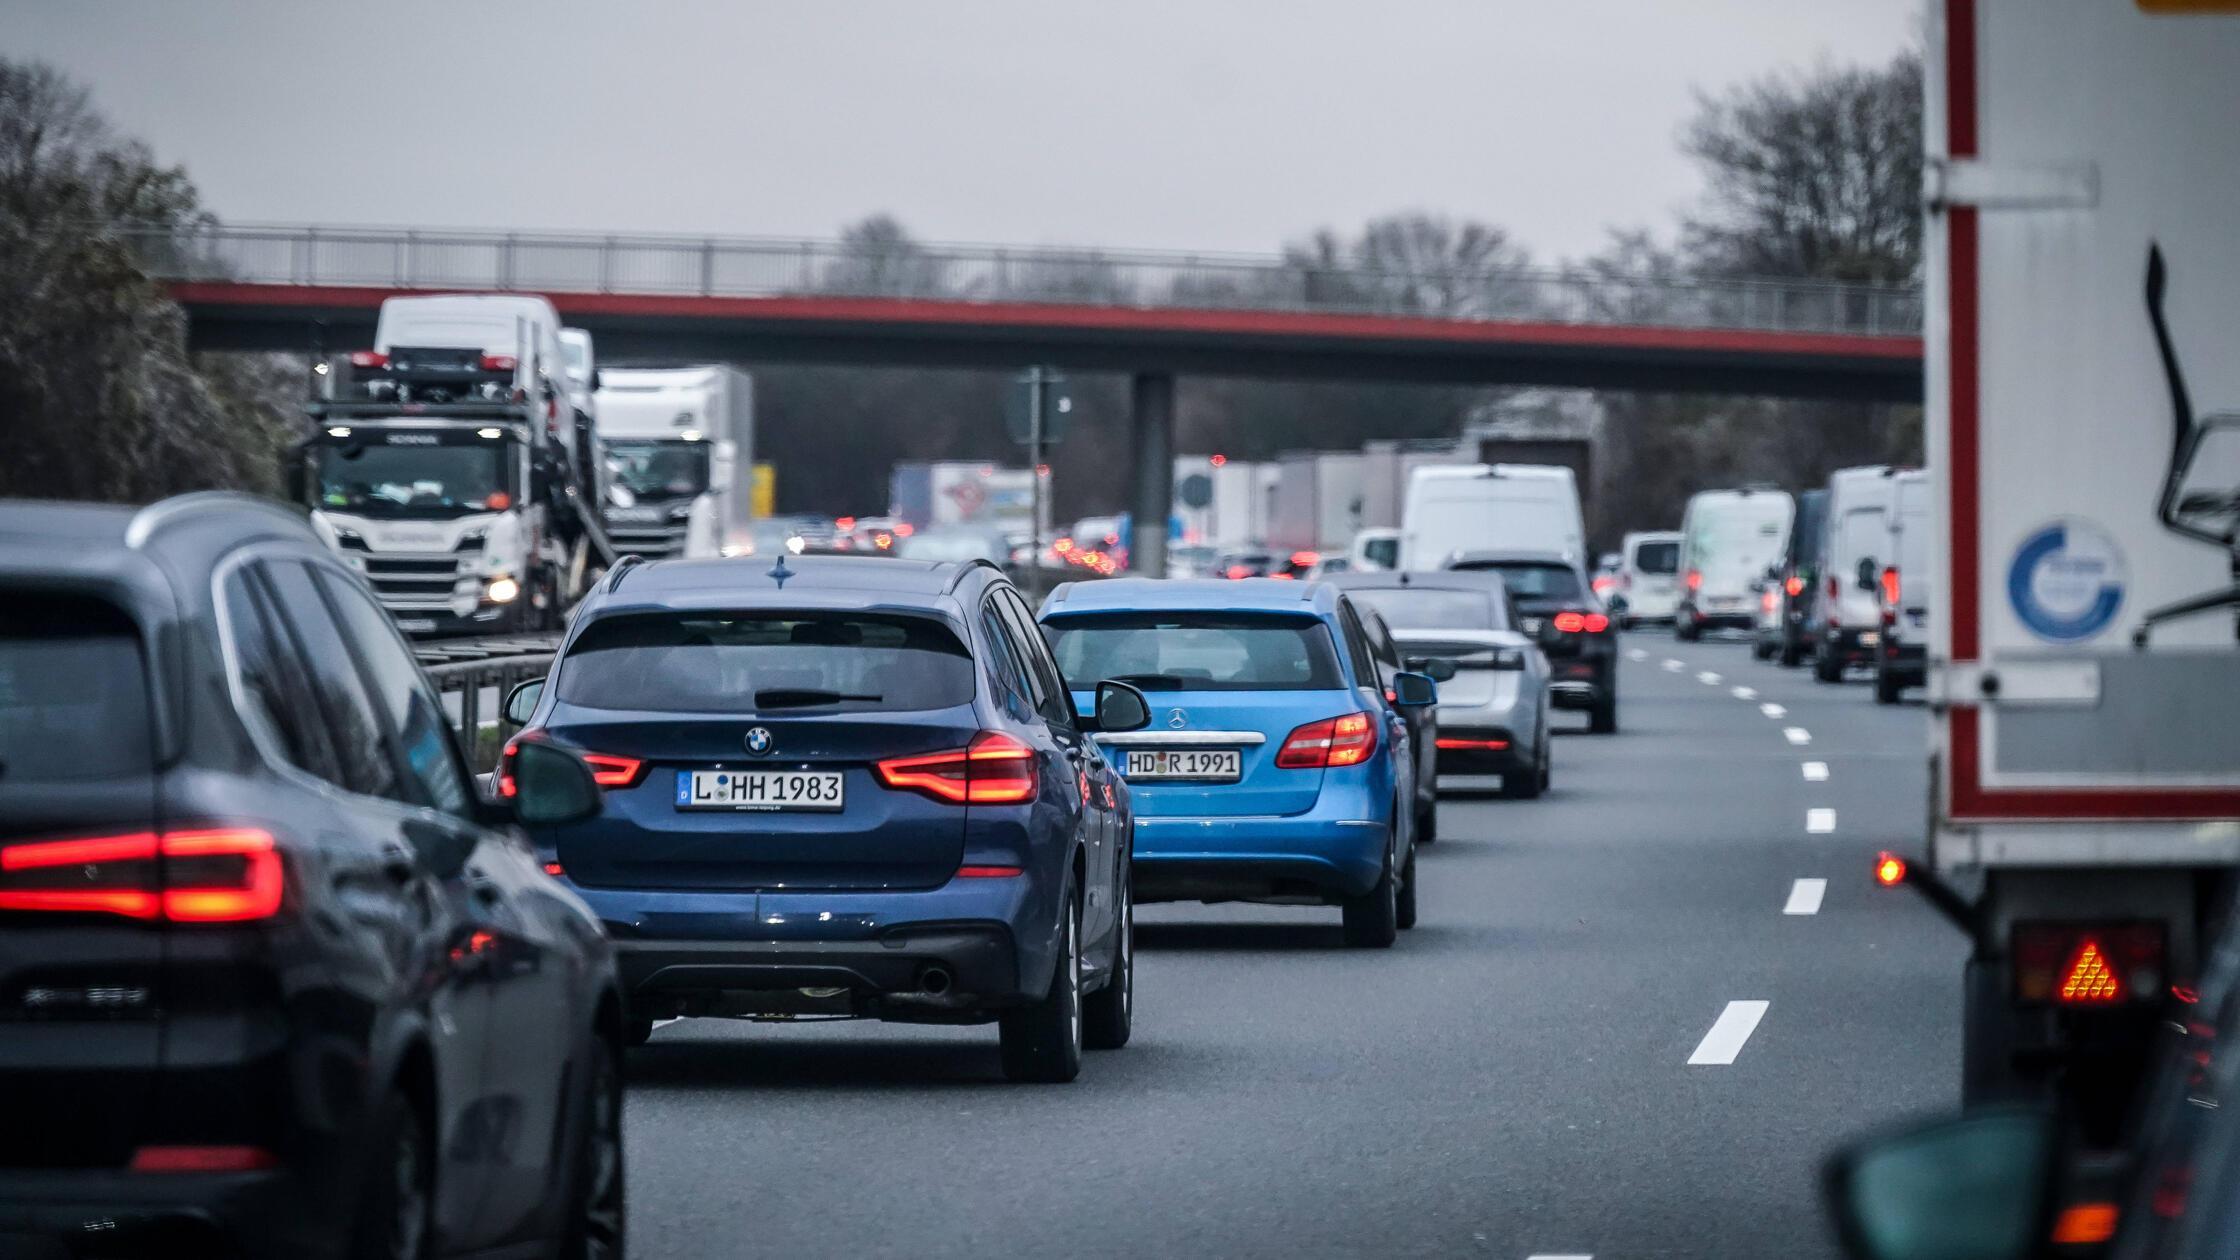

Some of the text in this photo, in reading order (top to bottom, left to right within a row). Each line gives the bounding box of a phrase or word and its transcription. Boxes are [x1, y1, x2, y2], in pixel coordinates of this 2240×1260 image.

[1129, 754, 1155, 773] HD
[1169, 754, 1181, 773] R
[1187, 754, 1236, 773] 1991
[696, 776, 839, 800] L HH 1983
